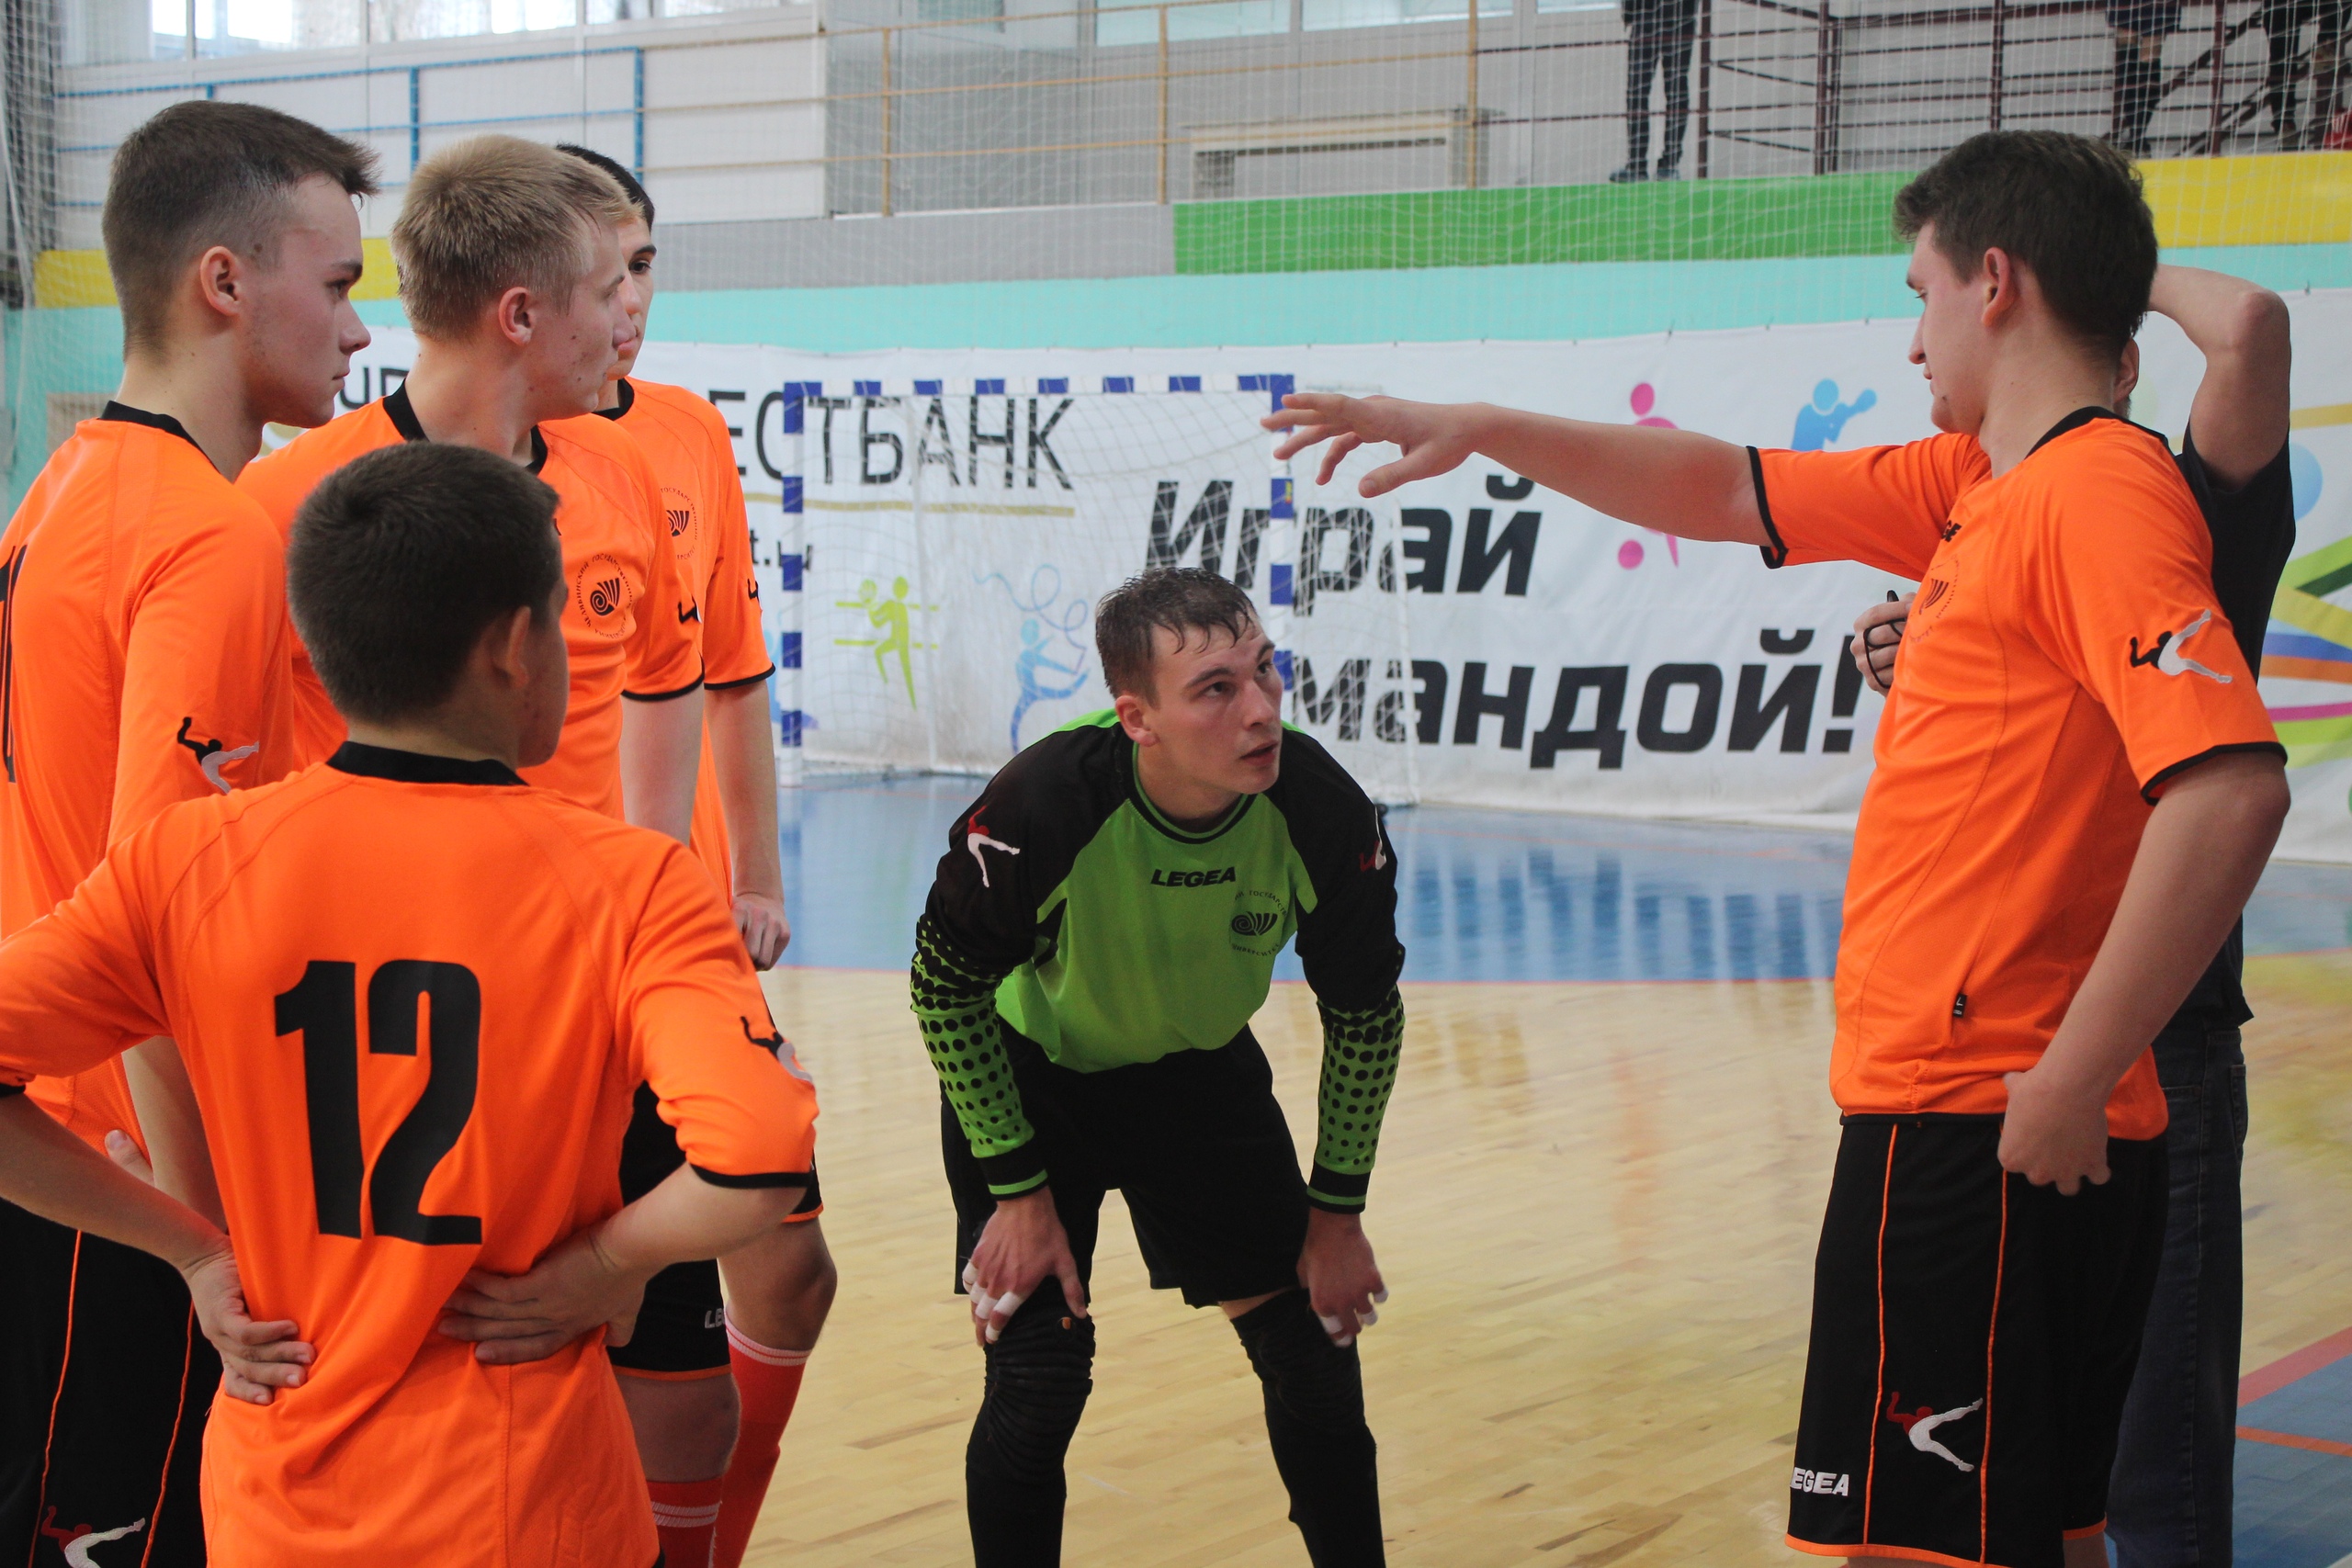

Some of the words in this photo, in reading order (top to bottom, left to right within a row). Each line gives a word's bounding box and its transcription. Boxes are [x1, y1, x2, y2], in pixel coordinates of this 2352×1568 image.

[1146, 475, 1542, 617] Играй
[1150, 866, 1236, 888] LEGEA
[274, 959, 482, 1246] 12
[1790, 1466, 1850, 1496] EGEA
